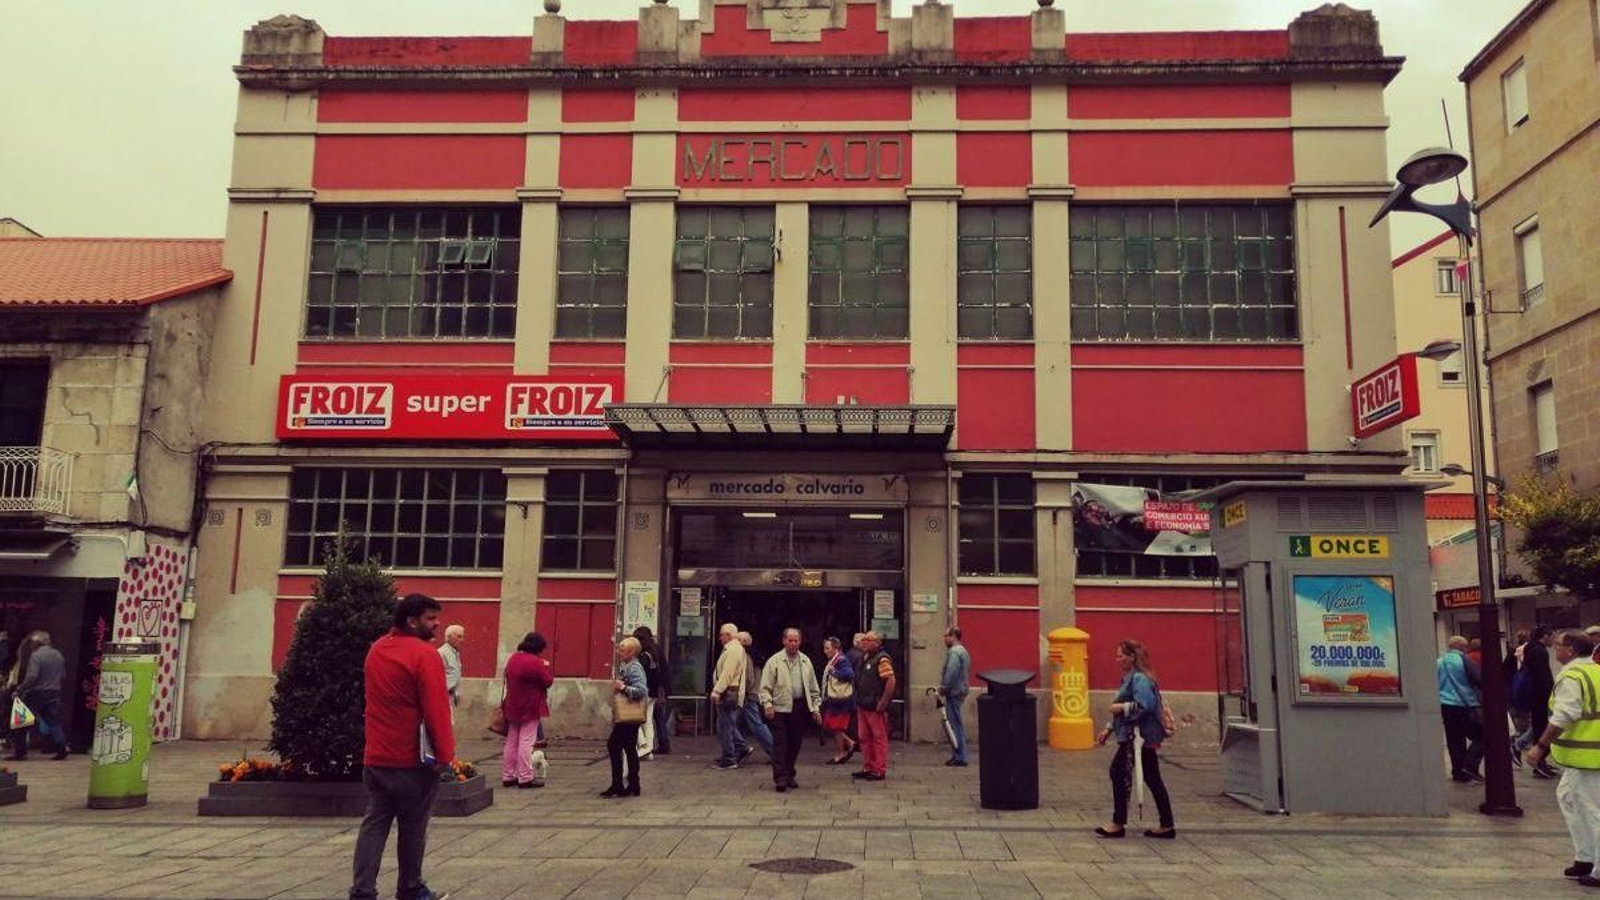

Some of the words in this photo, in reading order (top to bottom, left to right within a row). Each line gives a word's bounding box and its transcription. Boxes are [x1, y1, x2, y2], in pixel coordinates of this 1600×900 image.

[684, 138, 903, 181] MERCADO
[293, 386, 387, 415] FROIZ
[510, 386, 607, 416] FROIZ
[1359, 369, 1399, 415] FROIZ
[406, 393, 491, 417] super
[709, 478, 785, 494] mercado
[796, 478, 865, 494] calvario
[1145, 511, 1193, 521] COMERCIO
[1182, 503, 1194, 511] DE
[1146, 521, 1152, 529] E
[1319, 539, 1380, 554] ONCE
